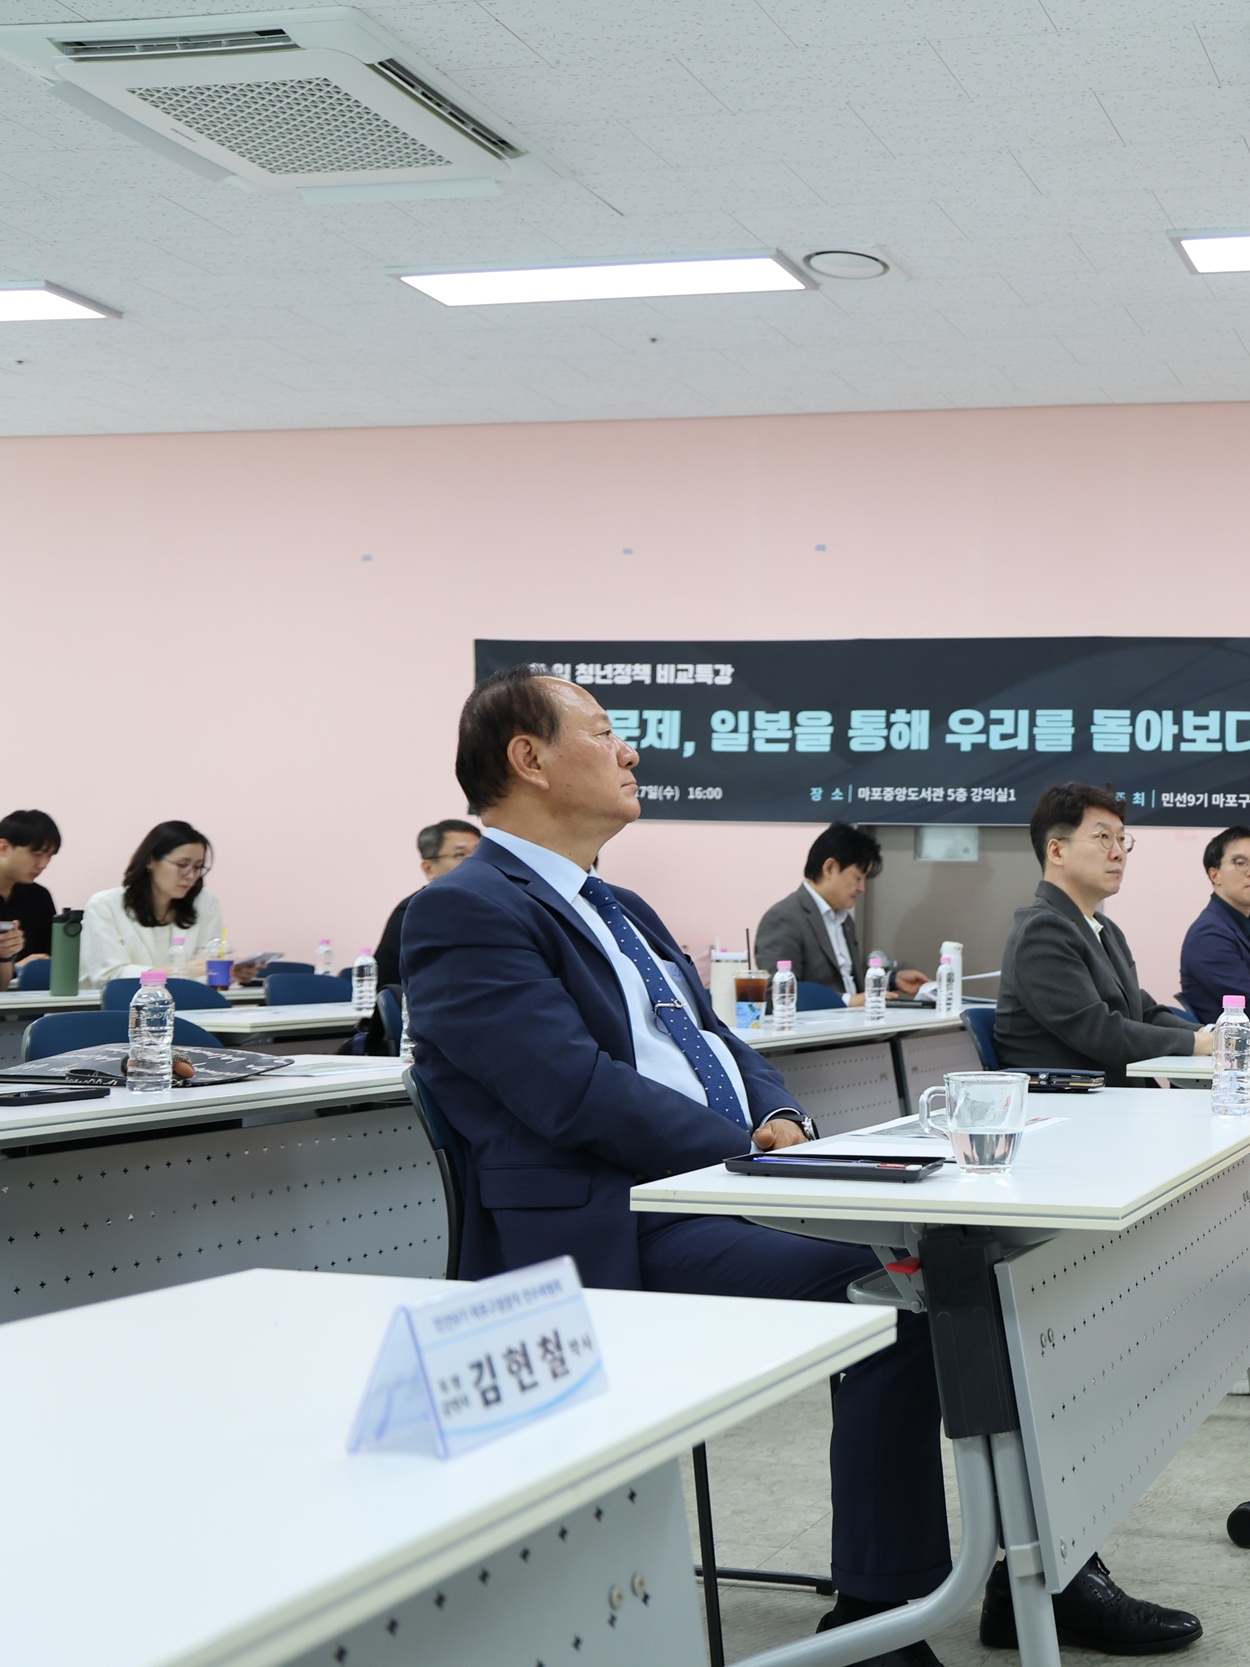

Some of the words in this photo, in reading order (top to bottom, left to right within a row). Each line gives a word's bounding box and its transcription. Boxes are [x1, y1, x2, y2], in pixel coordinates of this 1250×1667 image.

[575, 663, 651, 685] 청년정책
[656, 663, 734, 686] 비교특강
[710, 709, 833, 753] 일본을
[848, 709, 930, 752] 통해
[945, 709, 1075, 753] 우리를
[687, 786, 723, 799] 16:00
[857, 786, 945, 802] 마포중앙도서관
[947, 787, 968, 802] 5층
[970, 787, 1016, 803] 강의실1
[1161, 792, 1208, 808] 민선9기
